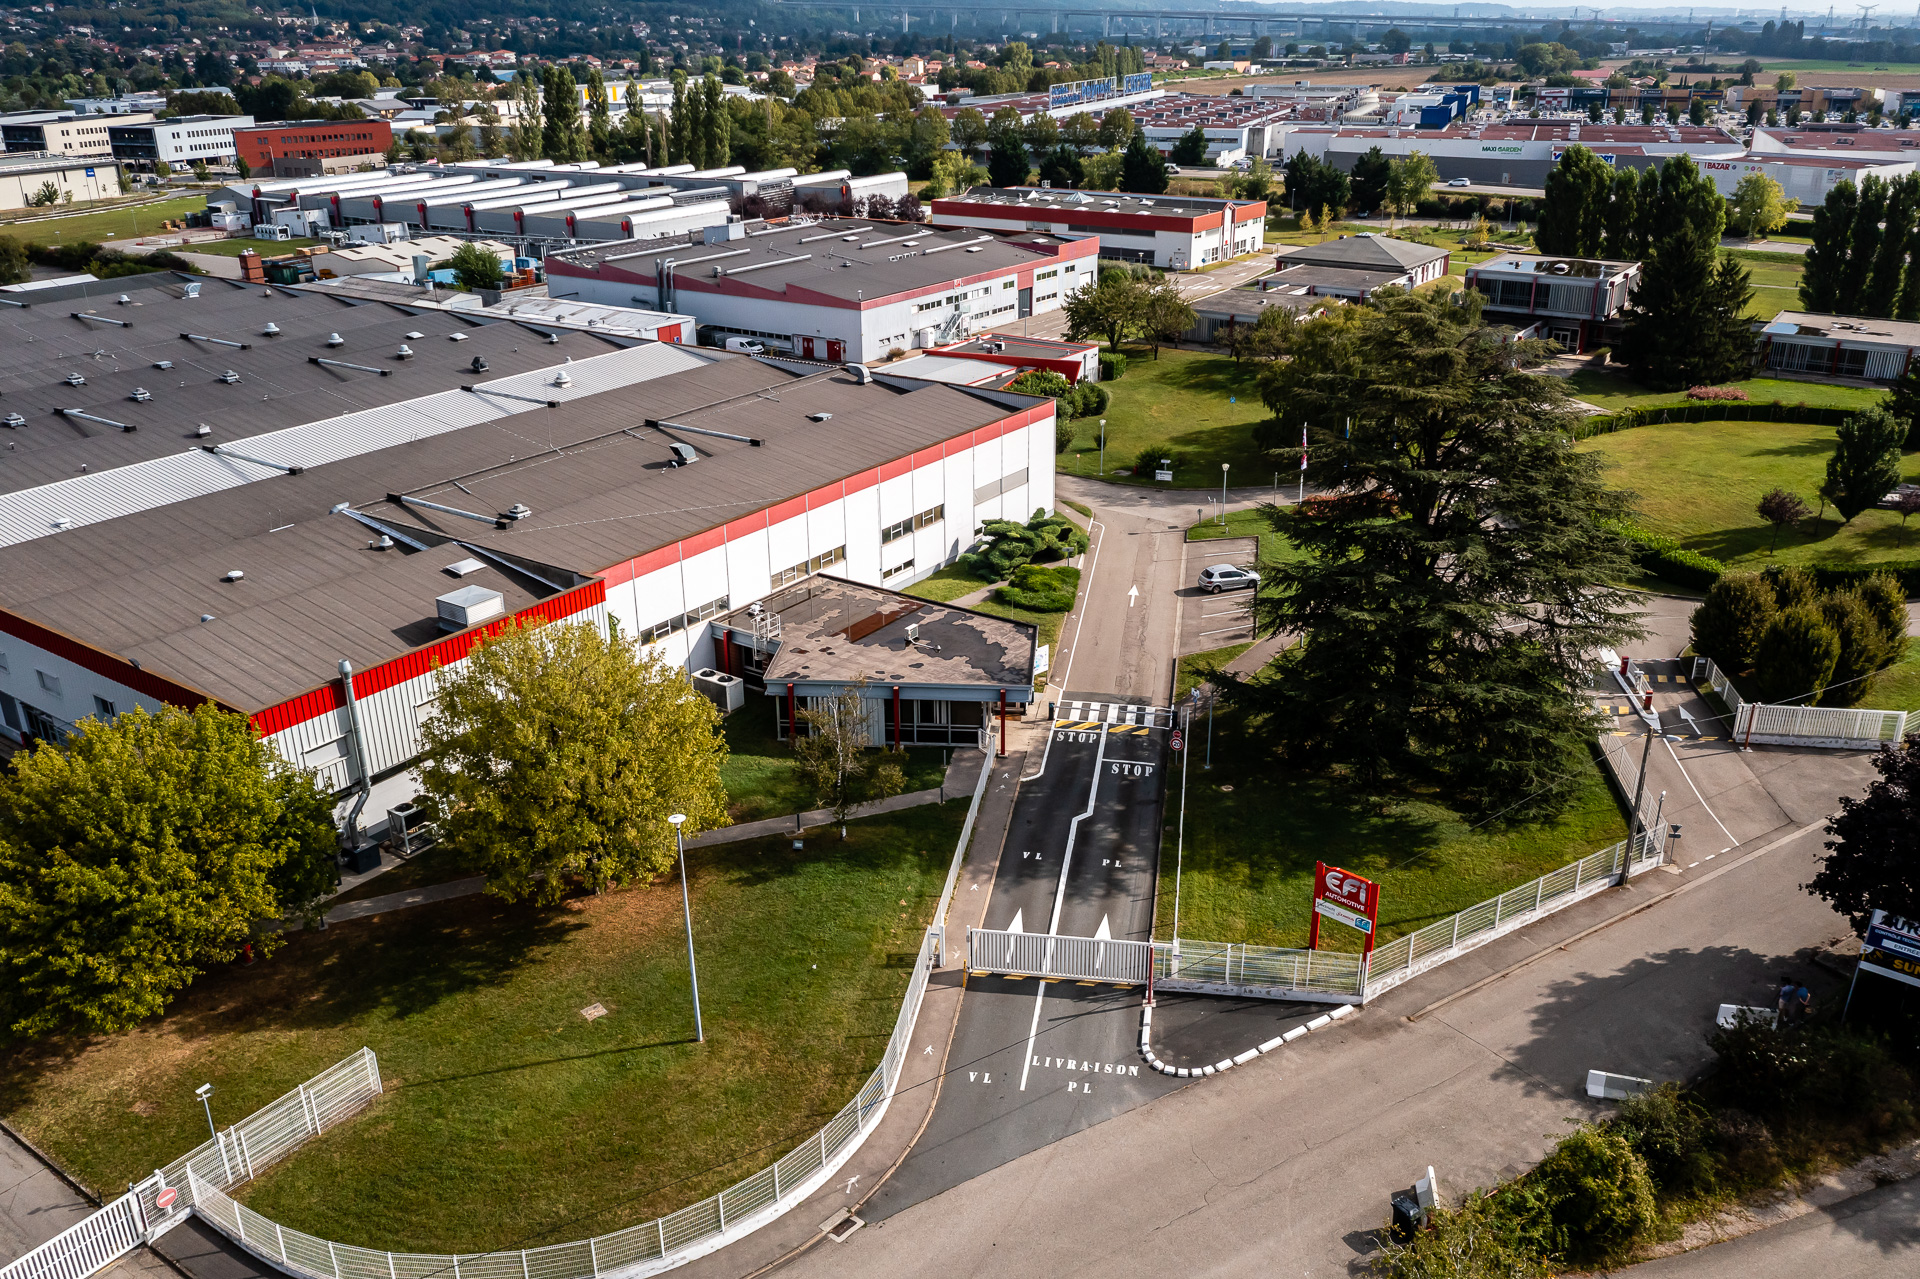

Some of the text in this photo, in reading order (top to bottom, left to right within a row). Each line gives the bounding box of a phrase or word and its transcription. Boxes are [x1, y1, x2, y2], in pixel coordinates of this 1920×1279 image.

[1707, 162, 1730, 170] BAZAR
[1056, 731, 1098, 743] STOP
[1111, 763, 1153, 777] STOP
[1325, 891, 1365, 912] AUTOMOTIVE
[1032, 1055, 1139, 1077] LIVRAISON
